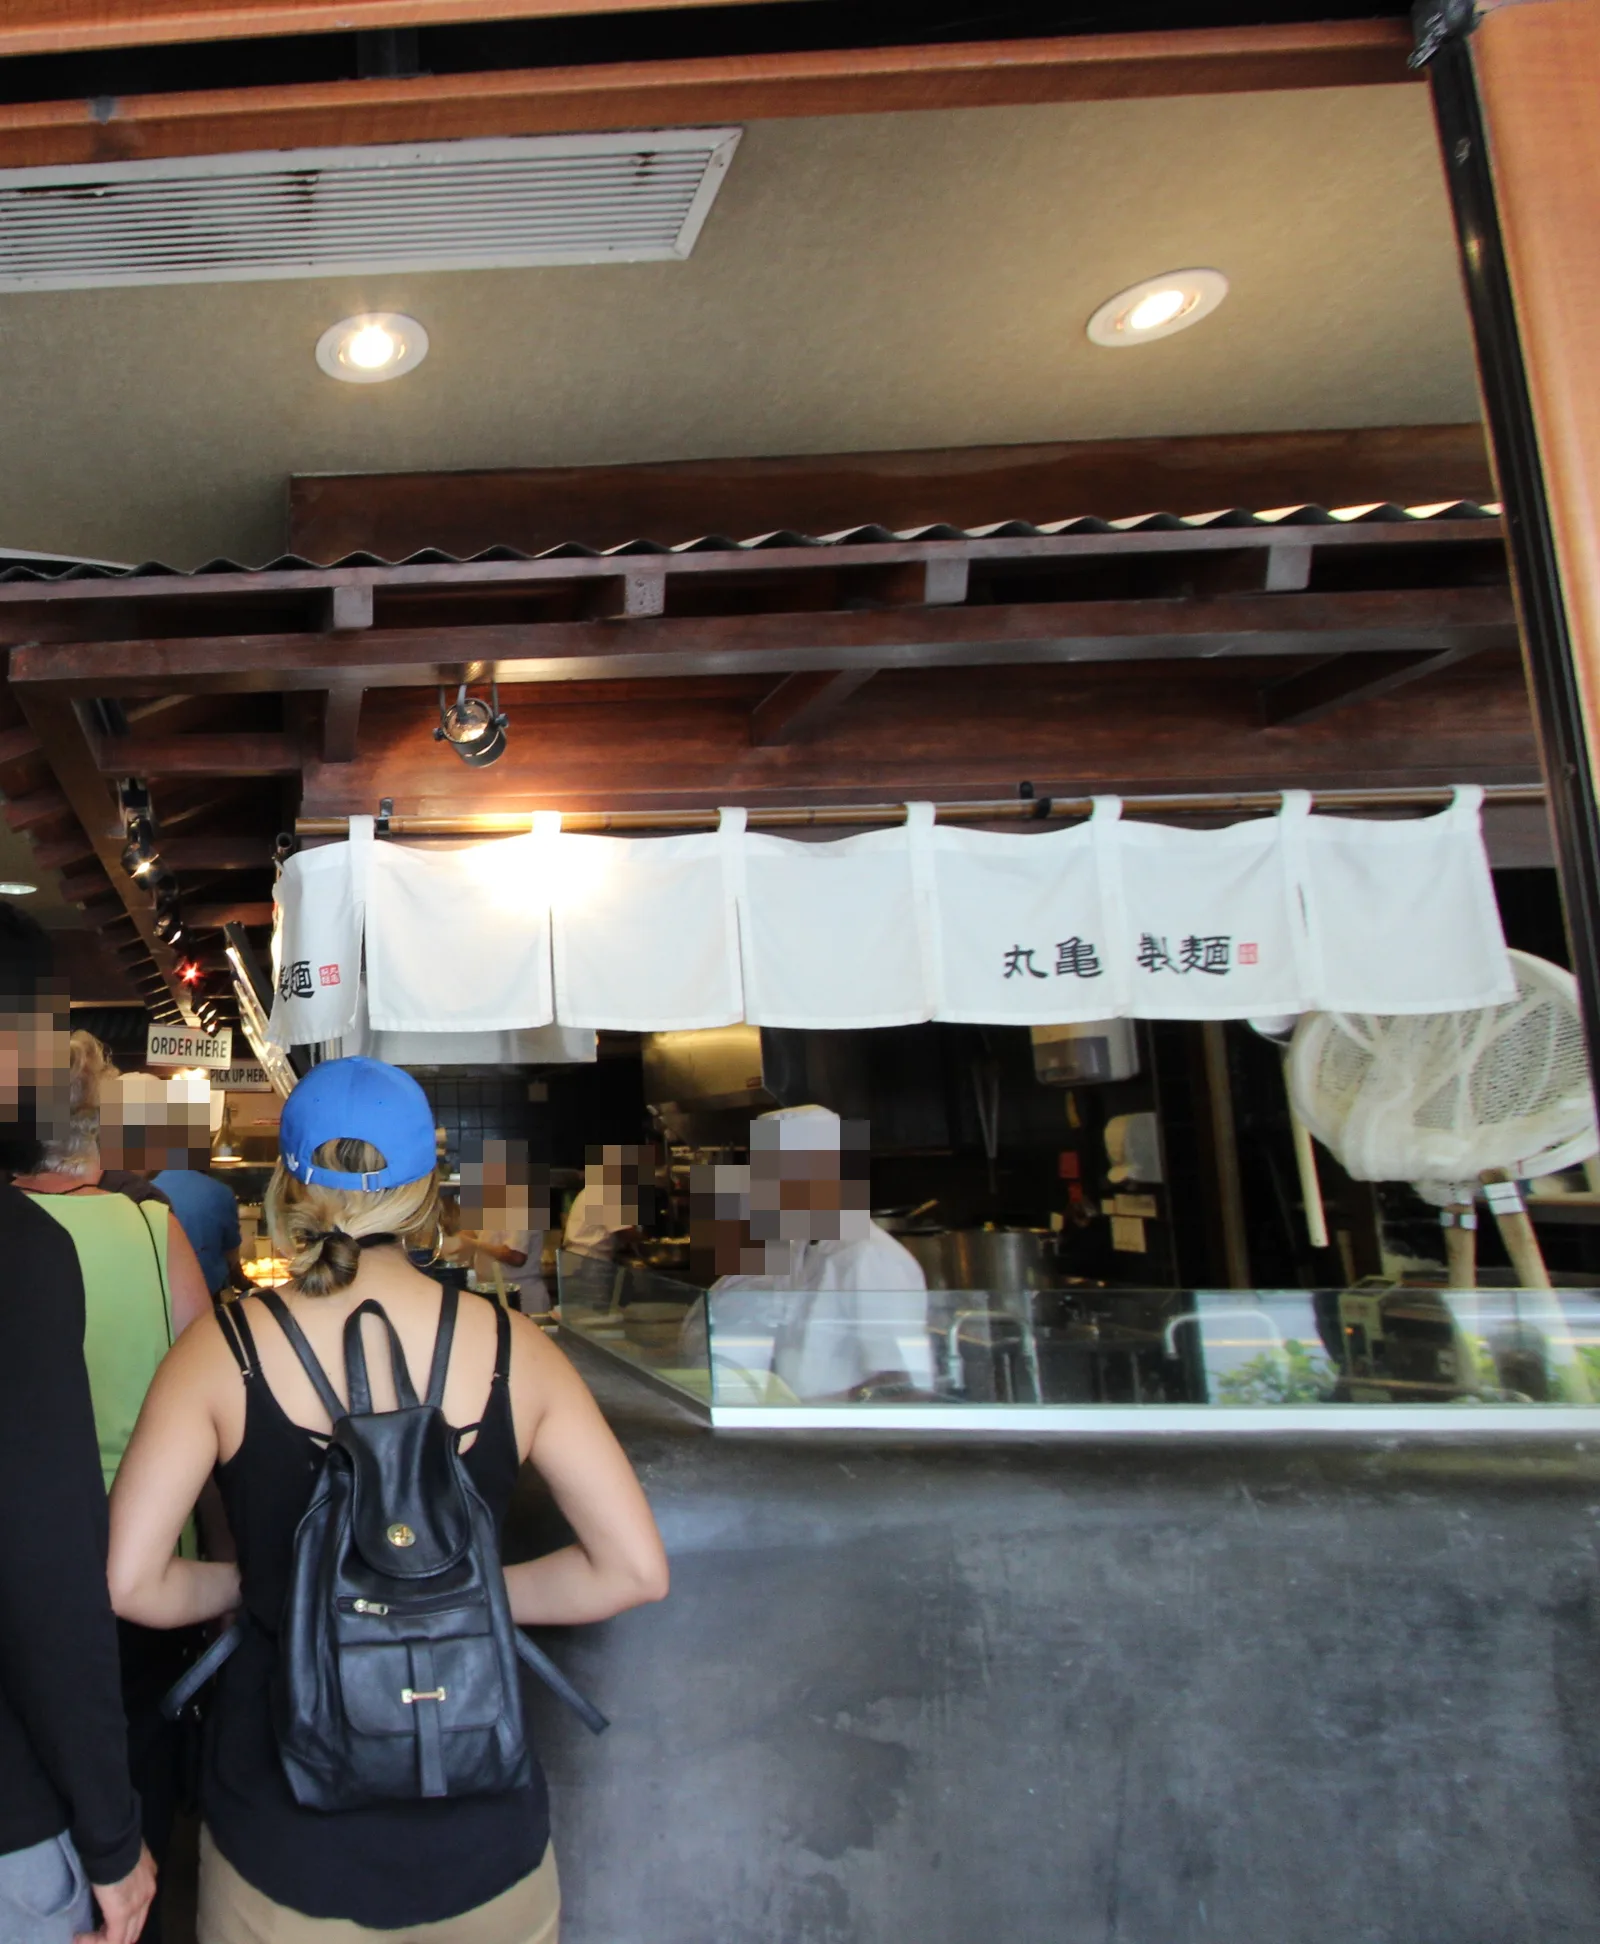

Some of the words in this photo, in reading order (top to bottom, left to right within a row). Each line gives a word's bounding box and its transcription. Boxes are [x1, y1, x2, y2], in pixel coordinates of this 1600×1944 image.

[151, 1036, 192, 1056] ORDER
[195, 1039, 227, 1058] HERE
[210, 1068, 231, 1082] PICK
[232, 1069, 245, 1082] UP
